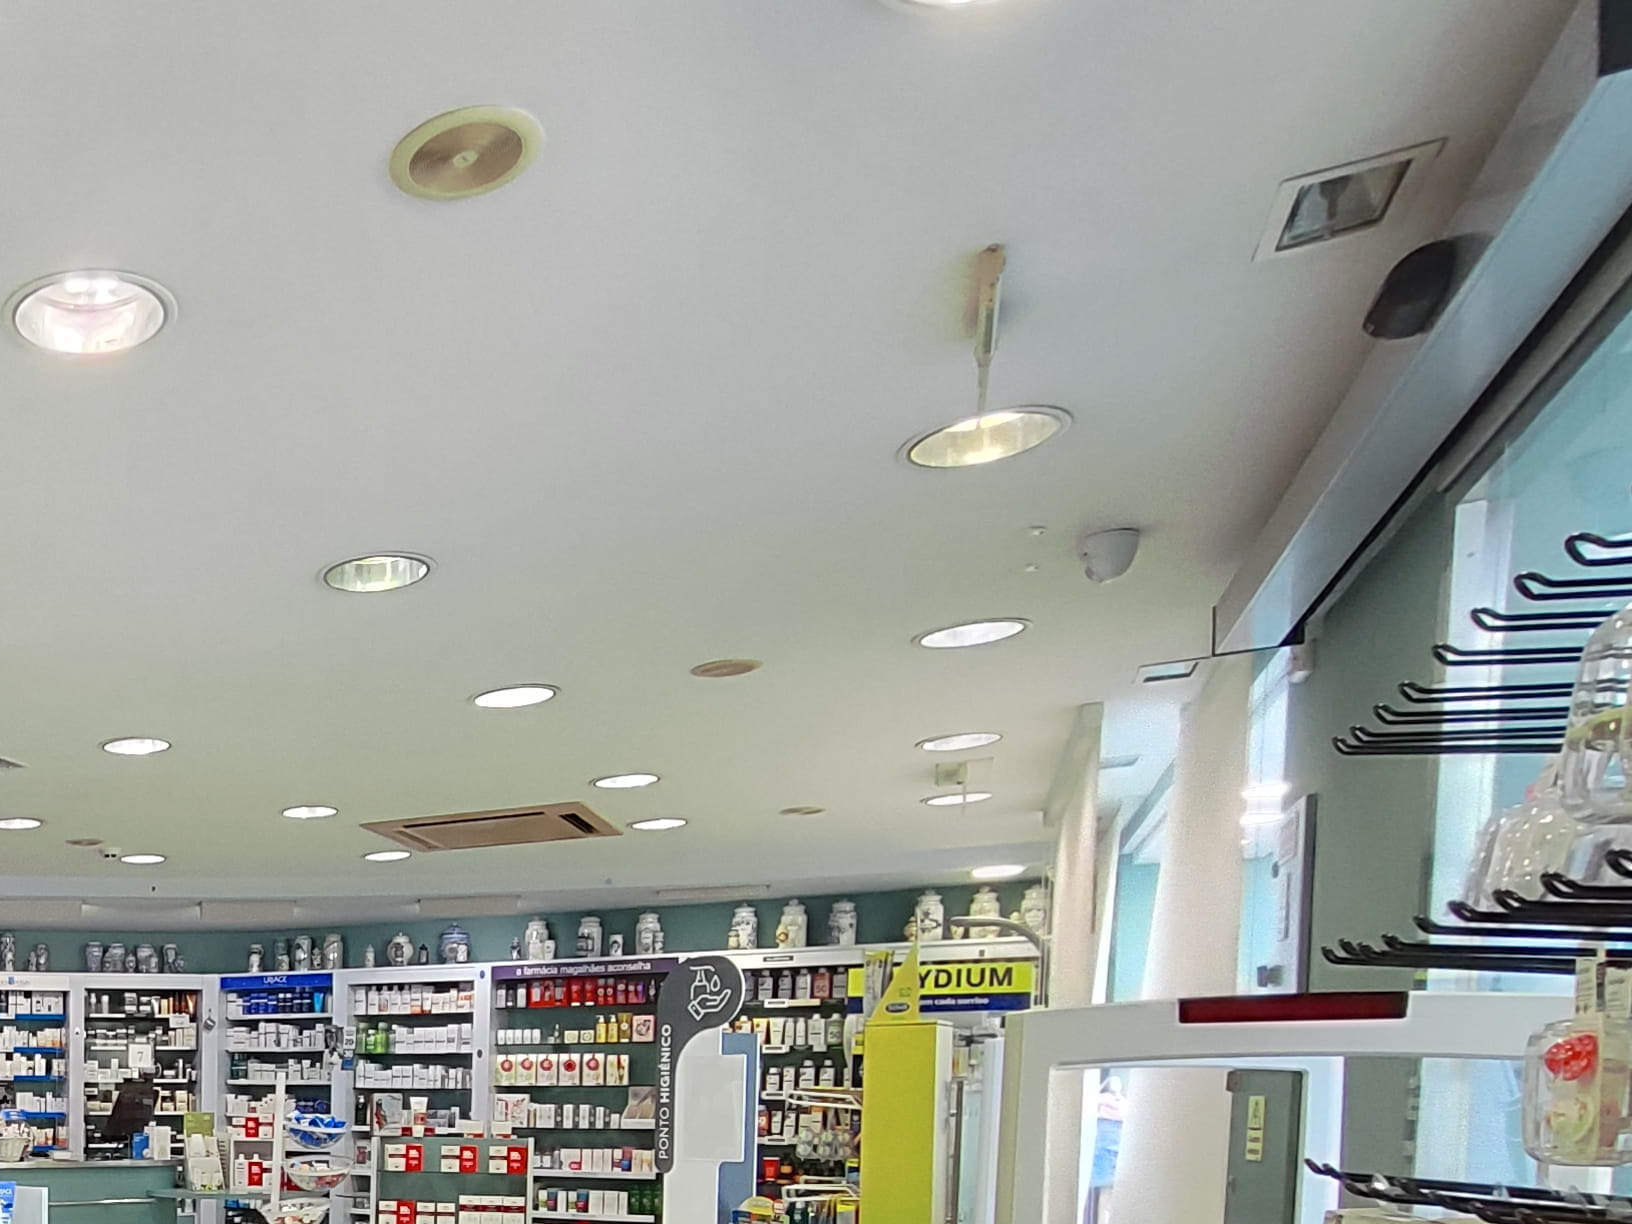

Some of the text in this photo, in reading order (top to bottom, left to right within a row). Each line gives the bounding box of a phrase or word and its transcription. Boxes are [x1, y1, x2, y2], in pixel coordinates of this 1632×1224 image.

[523, 965, 558, 975] farmácia
[607, 961, 652, 972] aconselha
[136, 1051, 145, 1063] 7
[658, 1107, 670, 1160] PONTO
